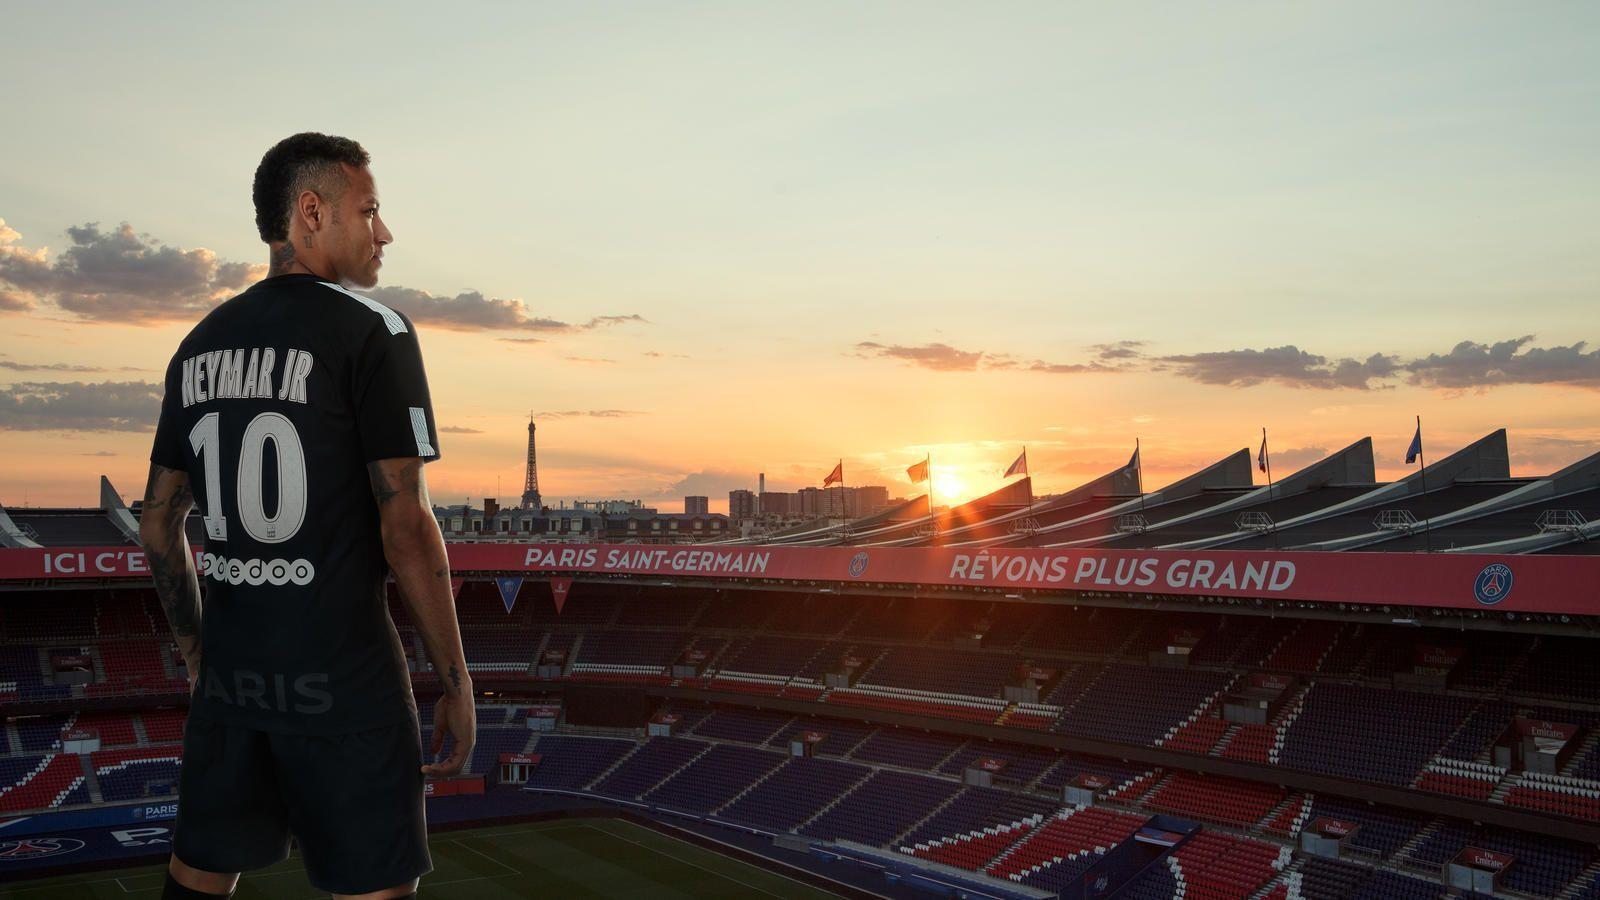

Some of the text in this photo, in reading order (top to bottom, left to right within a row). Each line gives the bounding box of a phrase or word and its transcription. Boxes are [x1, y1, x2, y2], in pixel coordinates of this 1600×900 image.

[182, 347, 314, 408] NEYMAR JR
[188, 411, 308, 544] 10
[44, 552, 150, 573] ICI C'E
[203, 552, 315, 586] ooedoo
[524, 548, 770, 573] PARIS SAINT-GERMAIN
[950, 550, 1296, 592] RÊVONS PLUS GRAND
[1531, 726, 1566, 738] Emirates
[145, 804, 178, 816] PARIS
